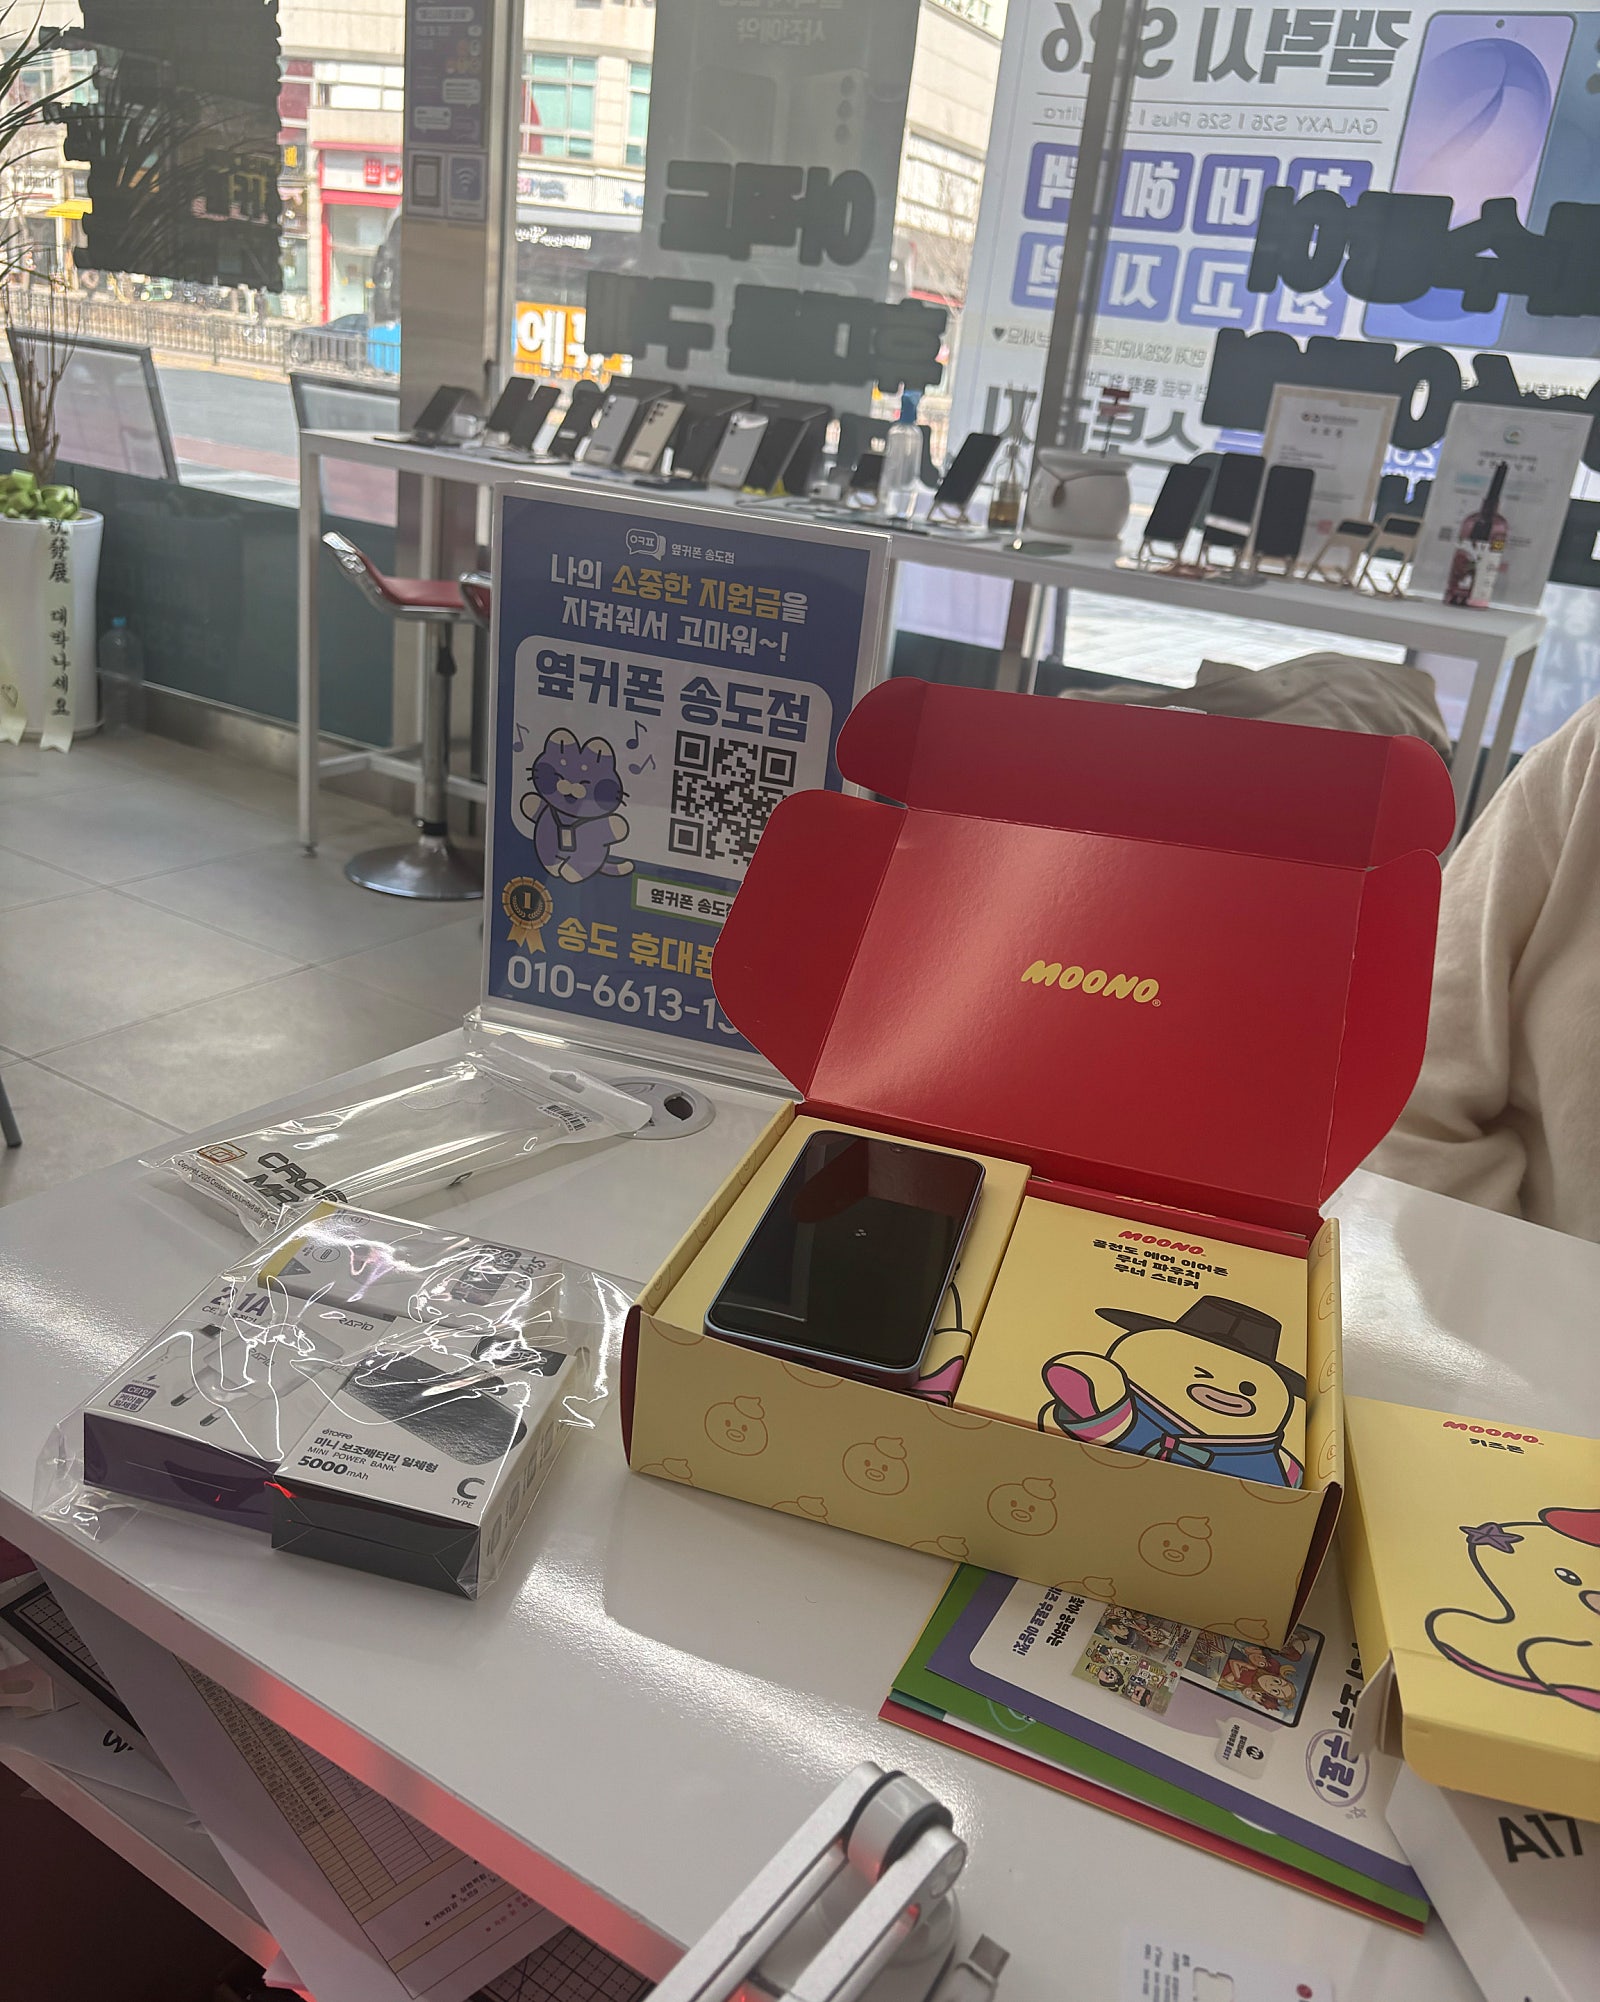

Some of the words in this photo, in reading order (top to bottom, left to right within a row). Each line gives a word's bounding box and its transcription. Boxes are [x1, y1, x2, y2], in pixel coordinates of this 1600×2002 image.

[671, 543, 703, 560] 옆커폰
[705, 547, 736, 565] 송도점
[550, 553, 602, 590] 나의
[611, 565, 692, 606] 소중한
[699, 577, 809, 625] 지원금을
[561, 596, 668, 642] 지켜줘서
[677, 615, 790, 662] 고마워~!
[536, 649, 665, 717] 옆커폰
[680, 676, 811, 743] 송도점
[650, 888, 694, 911] 옆커폰
[556, 916, 619, 960] 송도
[1021, 960, 1160, 1004] MOONO
[1118, 1230, 1205, 1256] MOONO
[1143, 1250, 1176, 1264] 에어
[1181, 1258, 1230, 1278] 이어폰
[1152, 1262, 1201, 1280] 파우치
[1150, 1272, 1200, 1290] 스티커
[1443, 1420, 1539, 1444] MOONO
[307, 1446, 330, 1456] MINI
[332, 1452, 367, 1465] POWER
[370, 1461, 398, 1472] BANK
[313, 1435, 338, 1450] 미니
[339, 1442, 401, 1465] 보조배터리
[401, 1456, 439, 1473] 일체형
[456, 1477, 486, 1500] C
[452, 1497, 475, 1509] TYPE
[1046, 1613, 1076, 1647] 공부하는
[1497, 1812, 1583, 1864] A17
